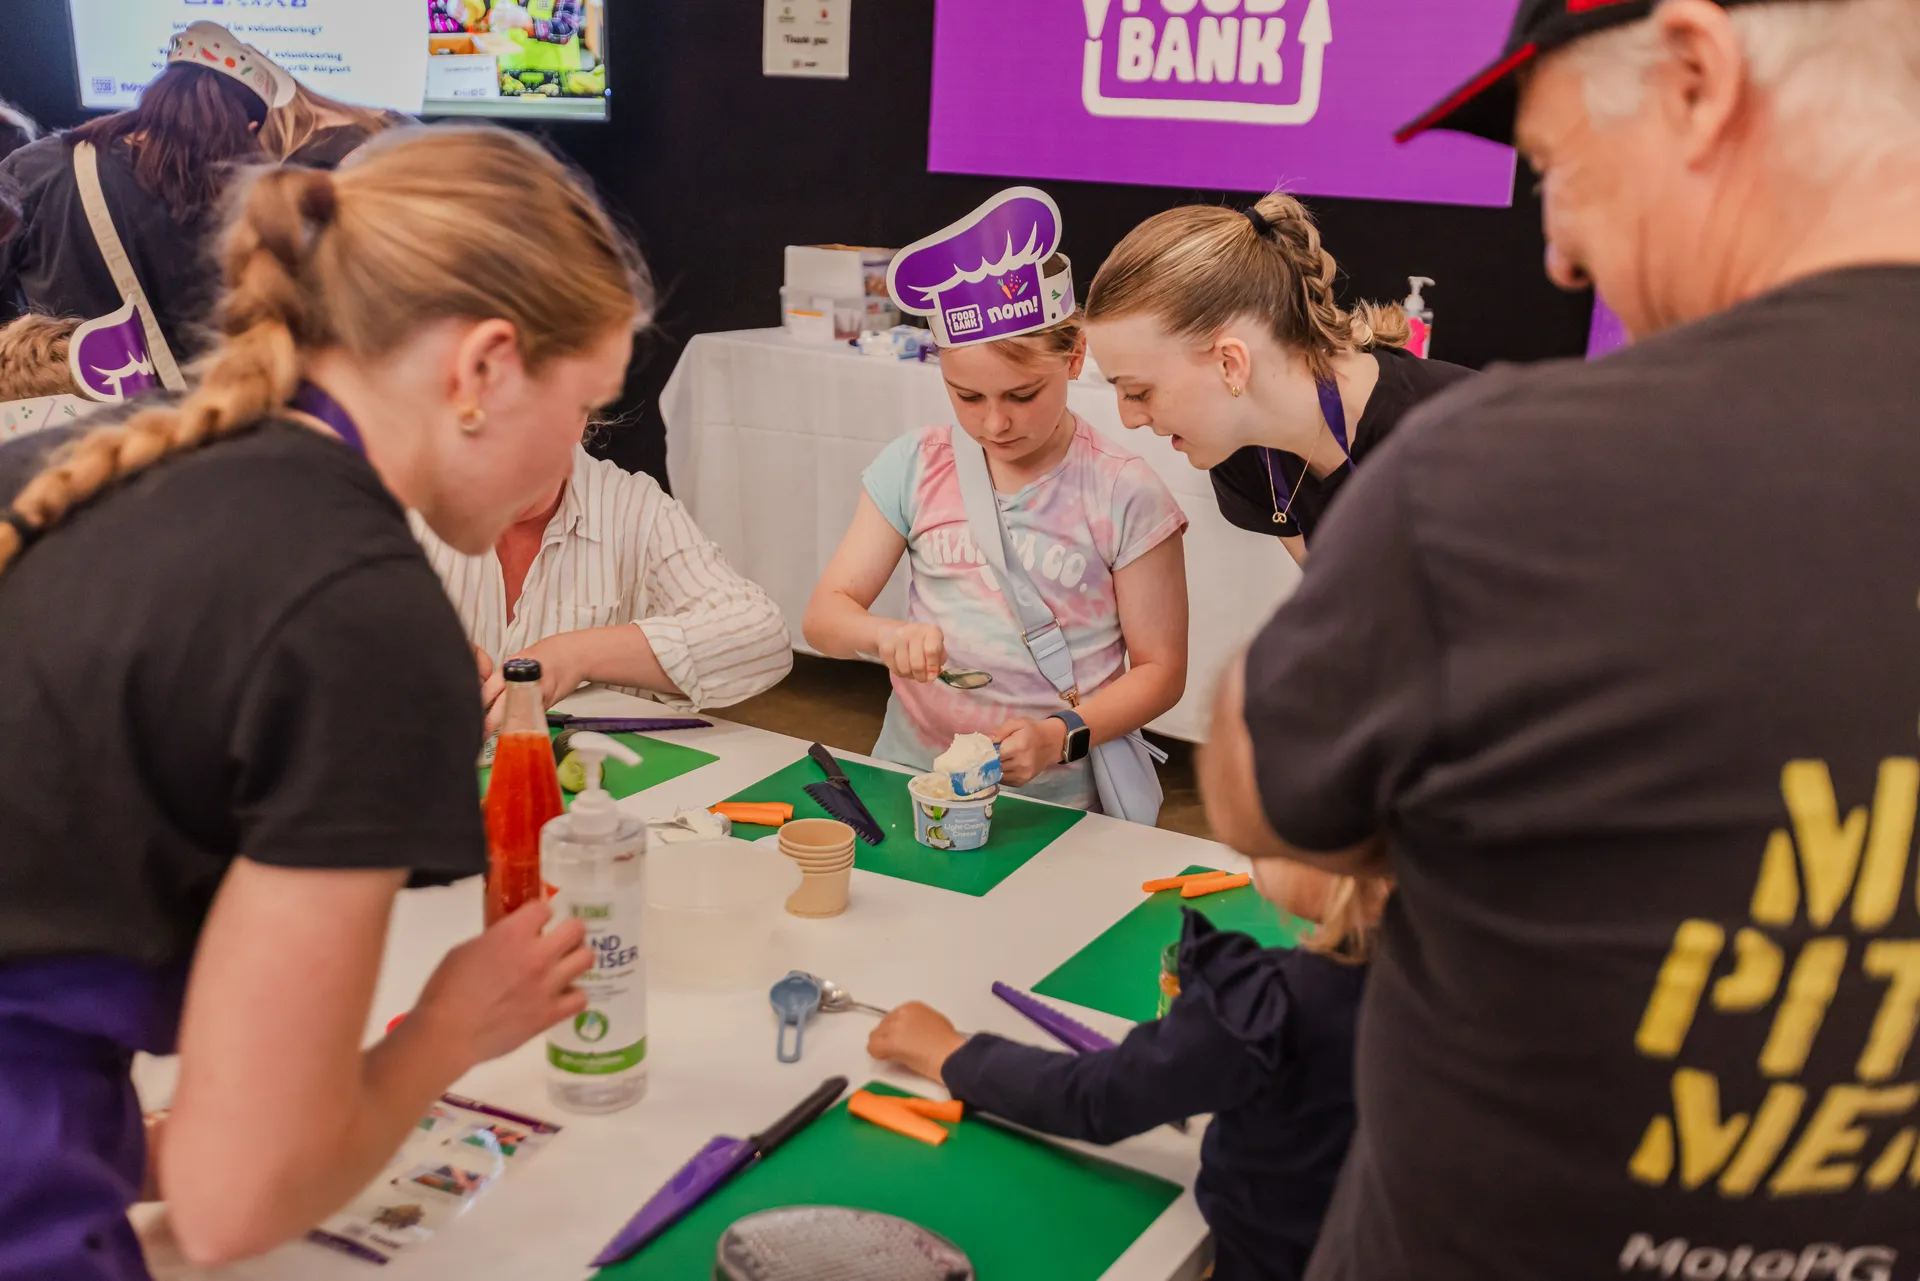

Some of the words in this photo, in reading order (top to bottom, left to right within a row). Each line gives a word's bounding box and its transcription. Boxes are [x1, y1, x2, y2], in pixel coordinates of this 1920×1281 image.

[1117, 16, 1286, 85] BANK
[951, 309, 976, 321] FOOD
[987, 295, 1039, 324] nom!
[953, 318, 978, 331] BANK
[592, 934, 621, 951] ND
